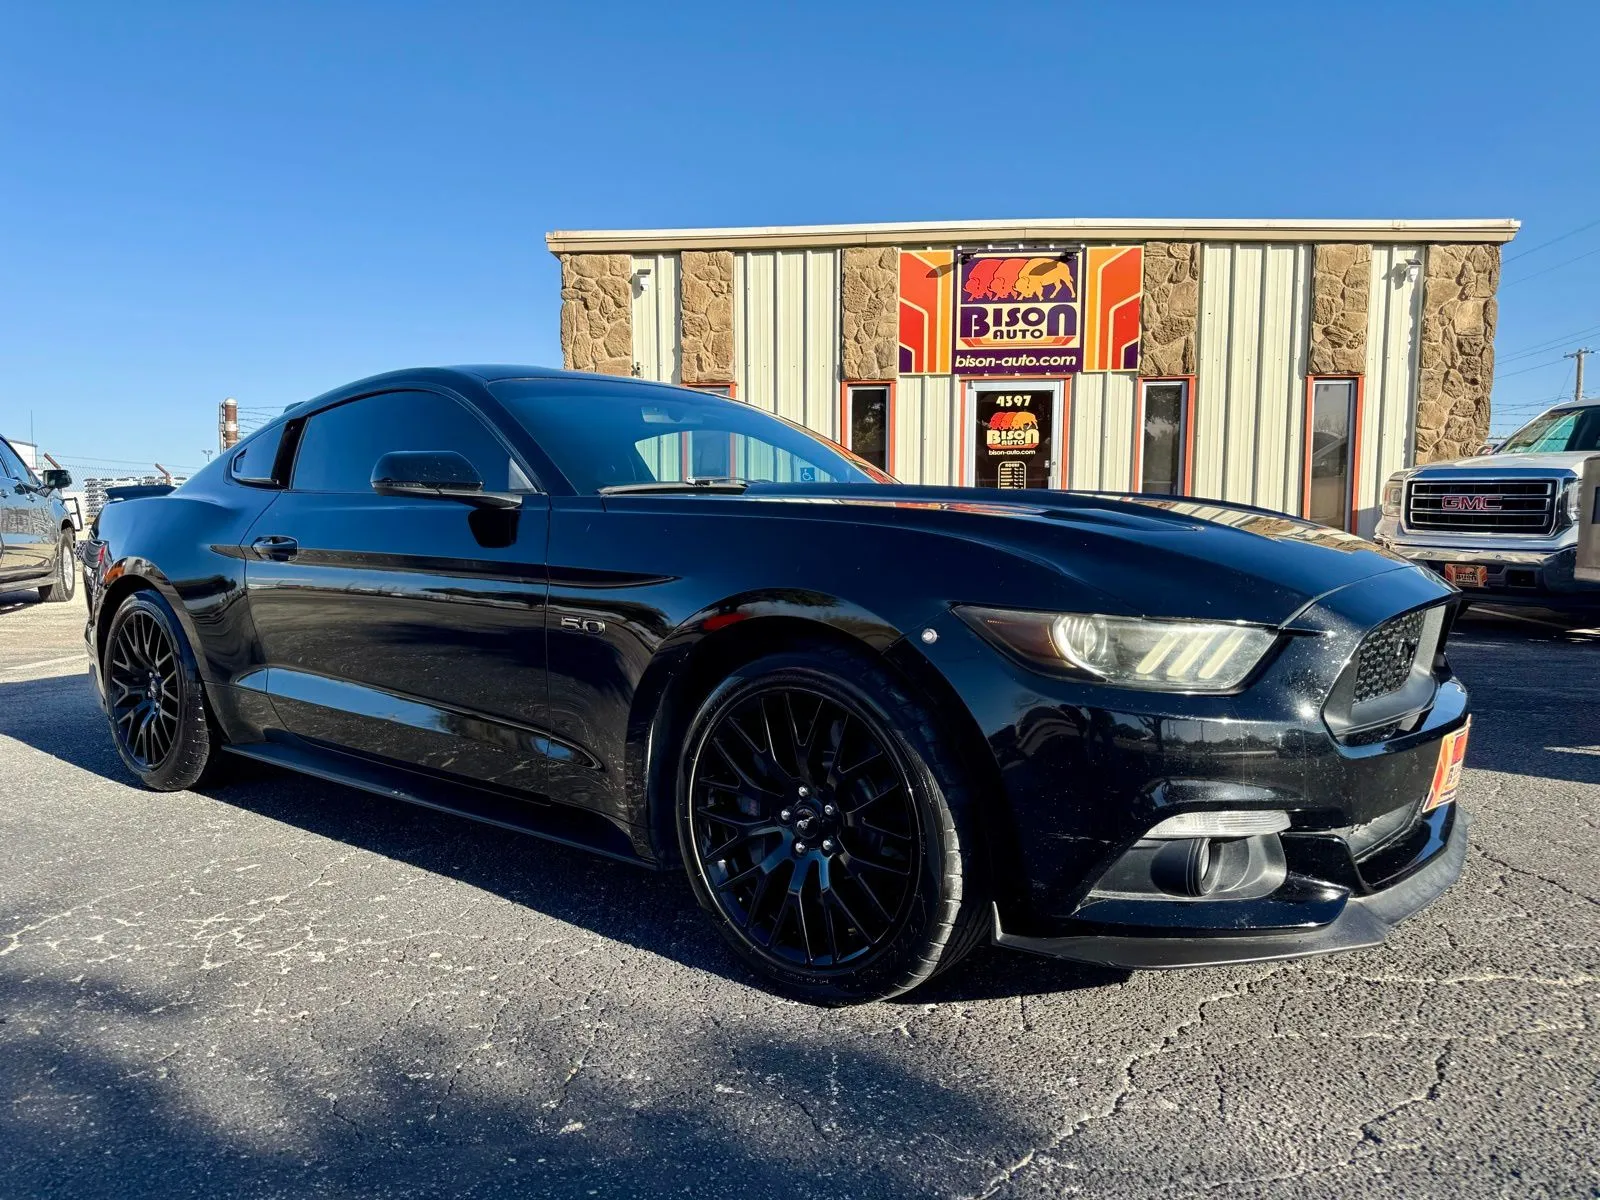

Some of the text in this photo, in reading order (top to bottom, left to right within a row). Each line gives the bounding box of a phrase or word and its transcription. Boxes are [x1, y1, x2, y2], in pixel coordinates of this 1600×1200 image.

[960, 304, 1077, 338] BISON
[993, 329, 1044, 340] AUTO
[955, 354, 1077, 368] bison-auto.com
[987, 429, 1040, 445] BISON
[1442, 495, 1504, 511] GMC
